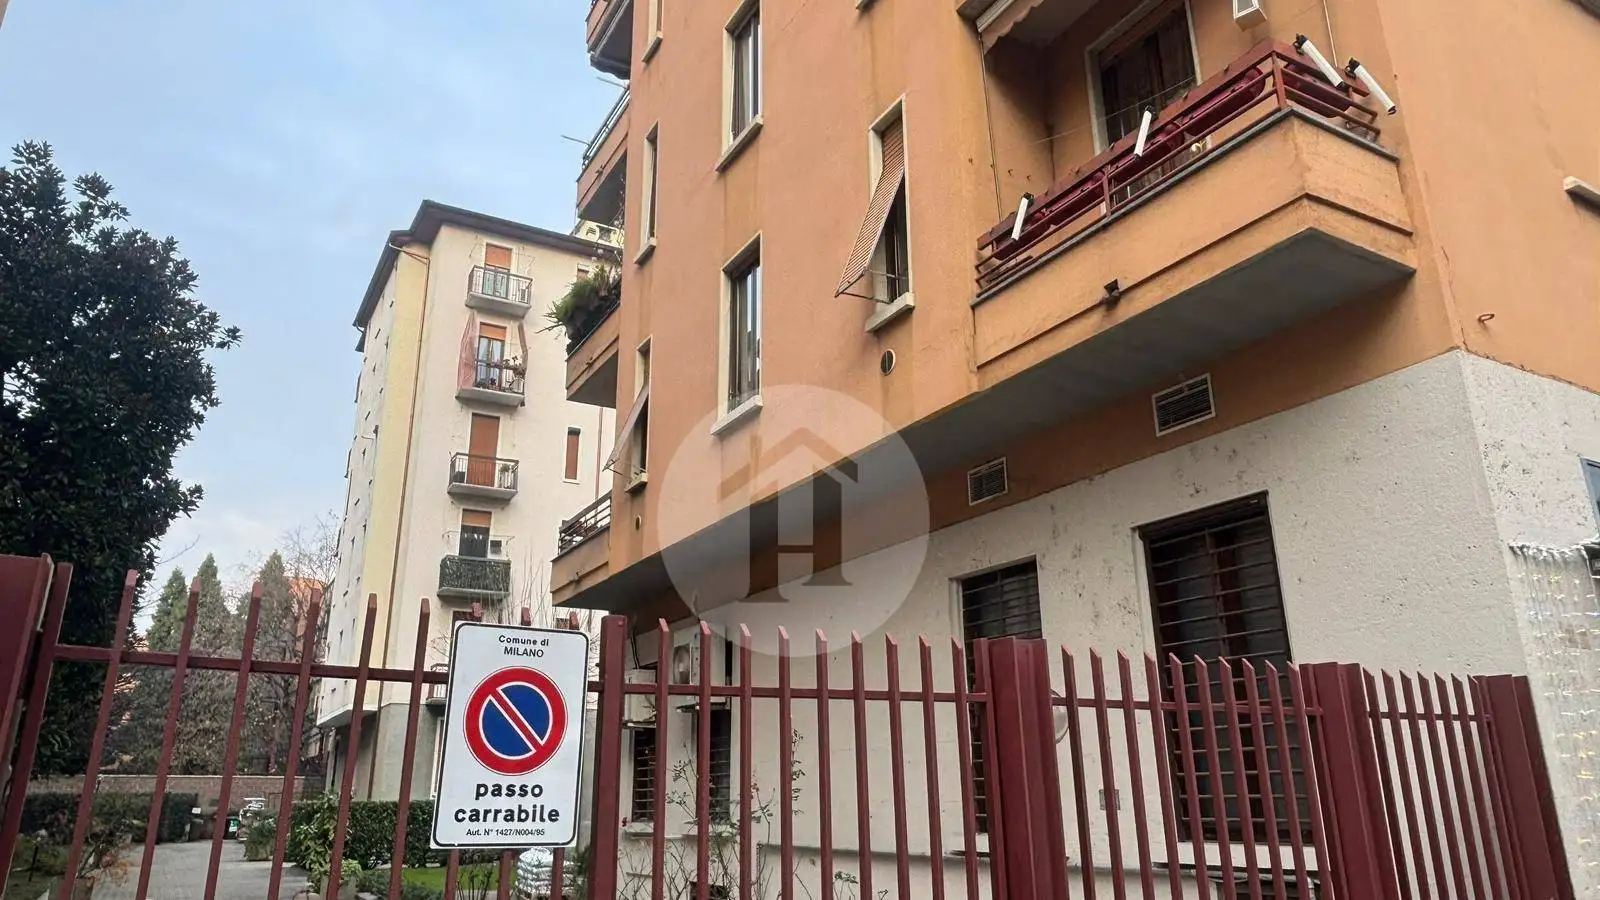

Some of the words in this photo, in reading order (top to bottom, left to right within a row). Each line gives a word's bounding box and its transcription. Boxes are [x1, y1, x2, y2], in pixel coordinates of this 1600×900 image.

[498, 634, 538, 646] Comune
[540, 638, 549, 646] di
[503, 646, 544, 657] MILANO
[475, 783, 544, 800] passo
[454, 804, 560, 823] carrabile
[466, 828, 482, 836] Aut.
